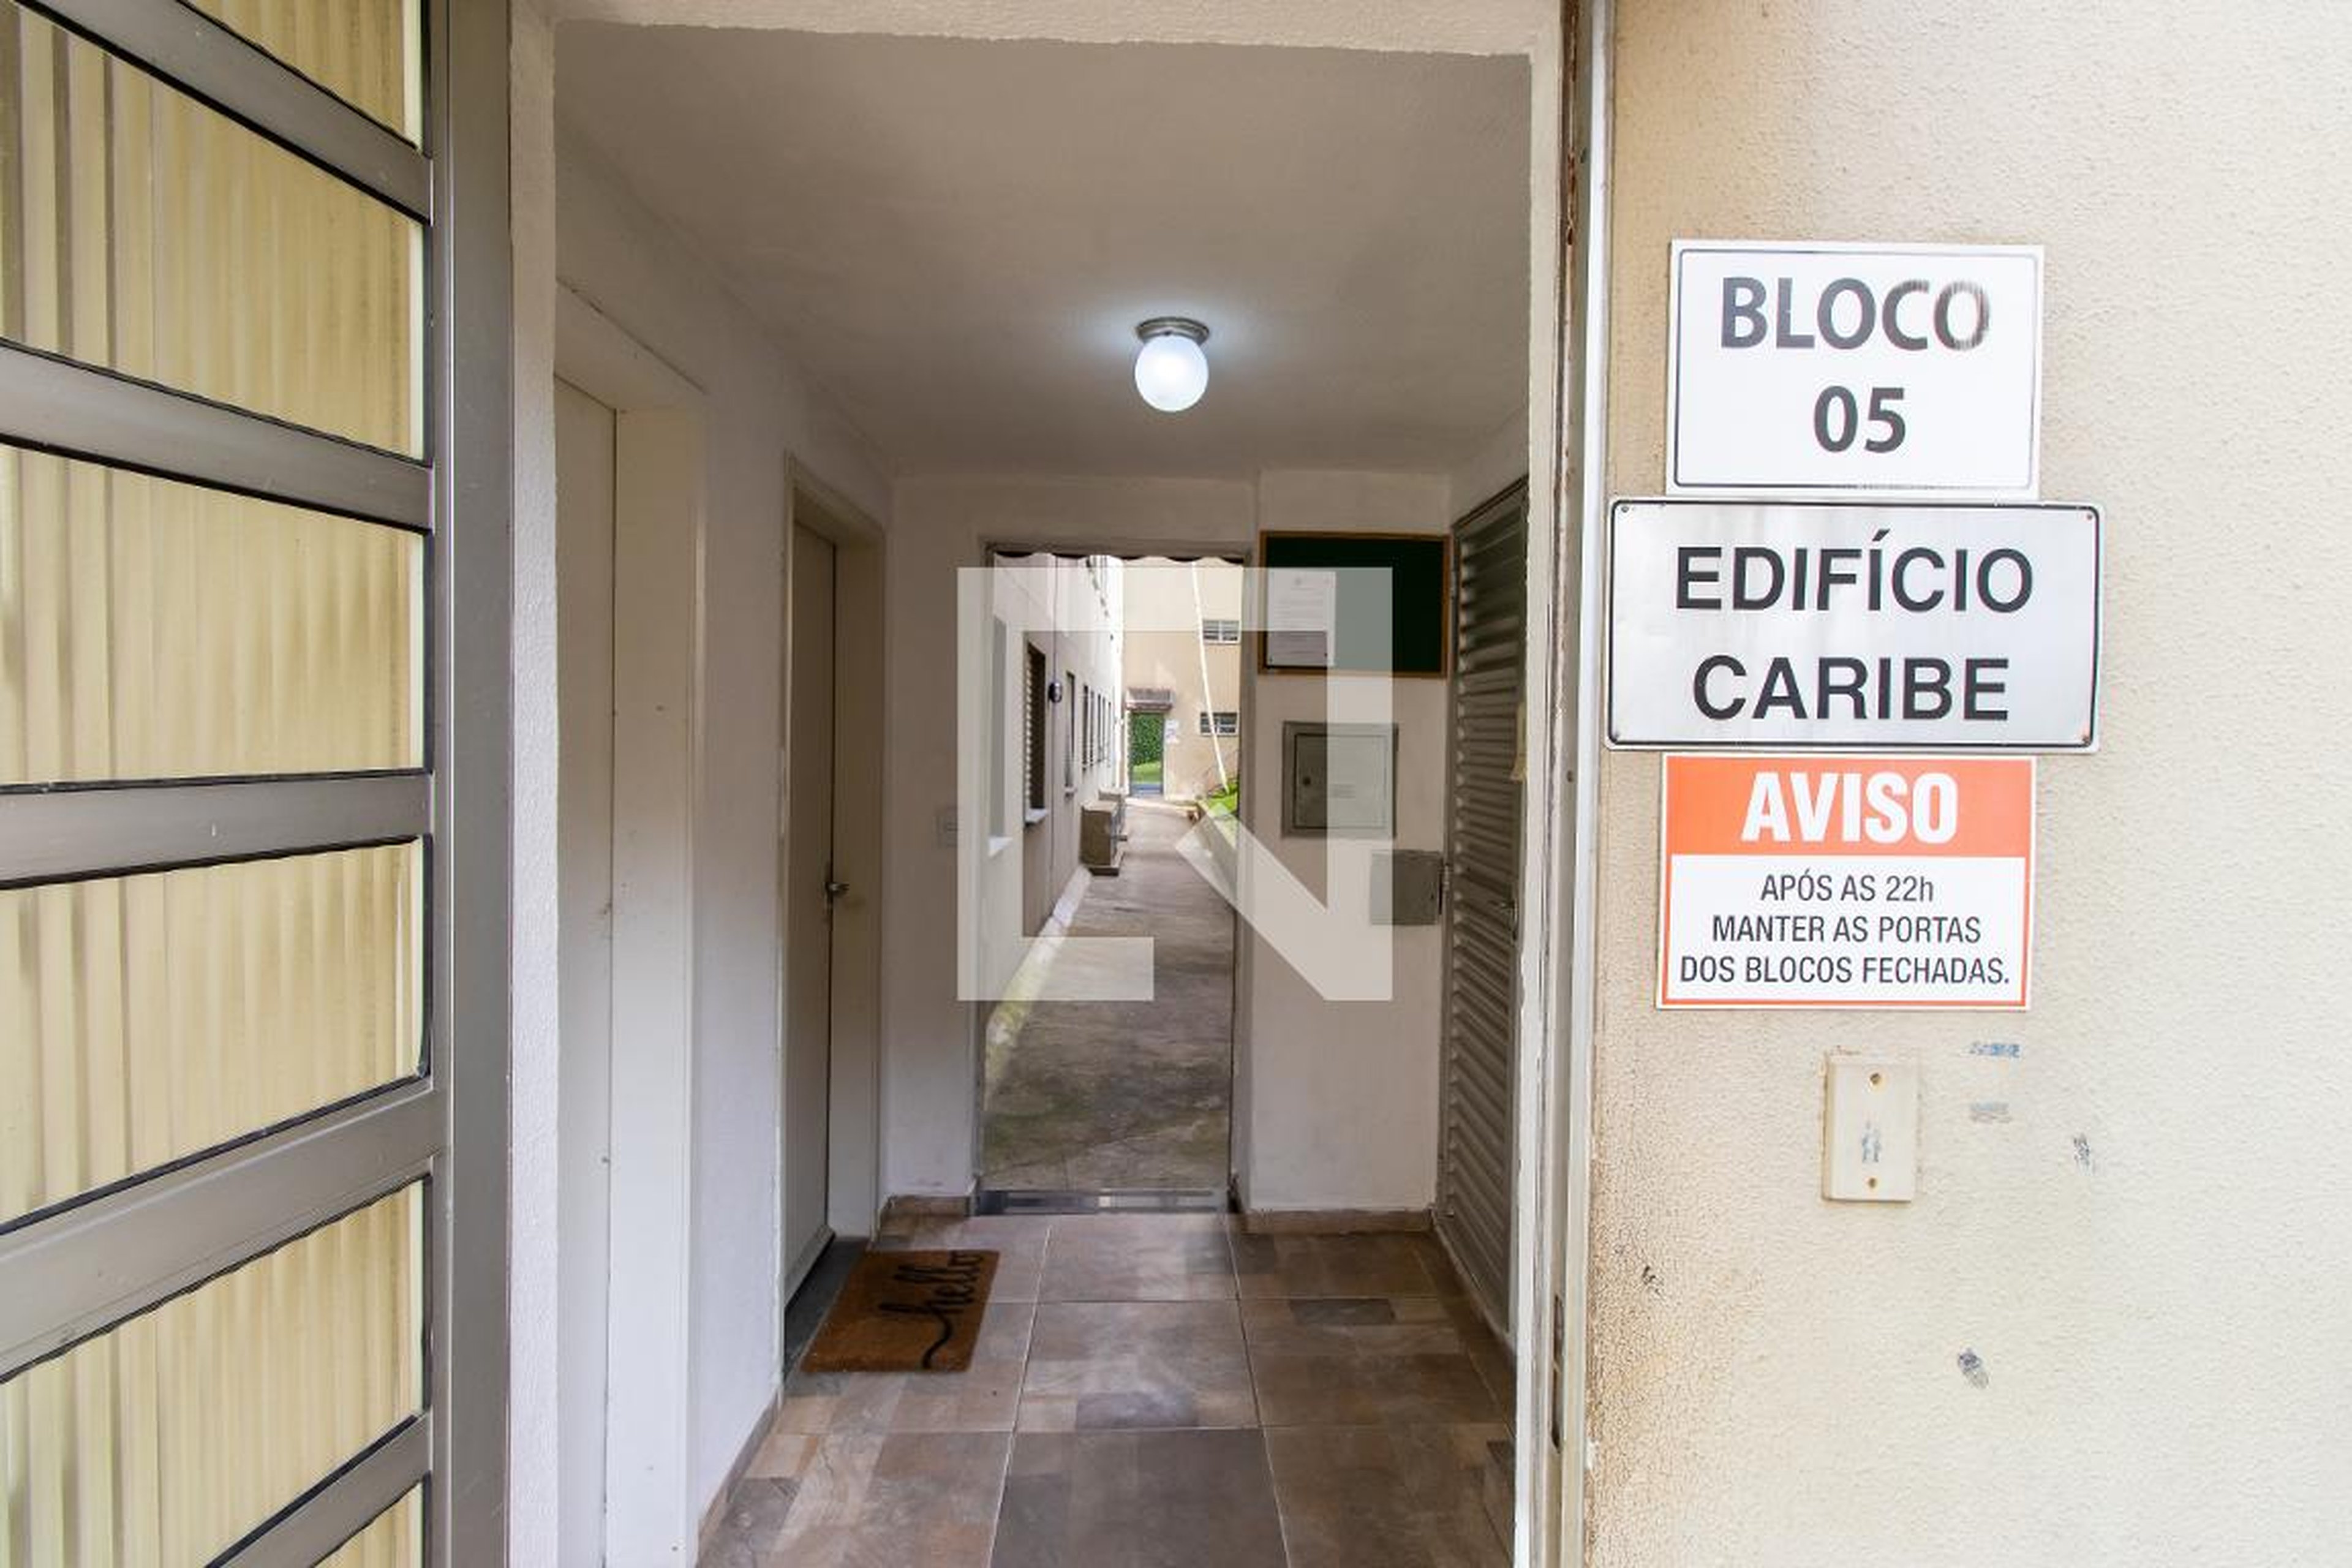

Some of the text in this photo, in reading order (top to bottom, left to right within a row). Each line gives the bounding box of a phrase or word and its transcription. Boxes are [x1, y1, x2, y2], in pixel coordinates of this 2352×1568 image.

[1722, 277, 1988, 350] BLOCO
[1814, 386, 1905, 453] 05
[1677, 530, 2032, 612] EDIFÍCIO
[1694, 655, 2008, 720] CARIBE
[1742, 772, 1958, 843] AVISO
[1761, 869, 1933, 901] APÓS AS 22h
[1713, 916, 1980, 943] MANTER AS PORTAS
[1681, 956, 2008, 984] DOS BLOCOS FECHADAS.
